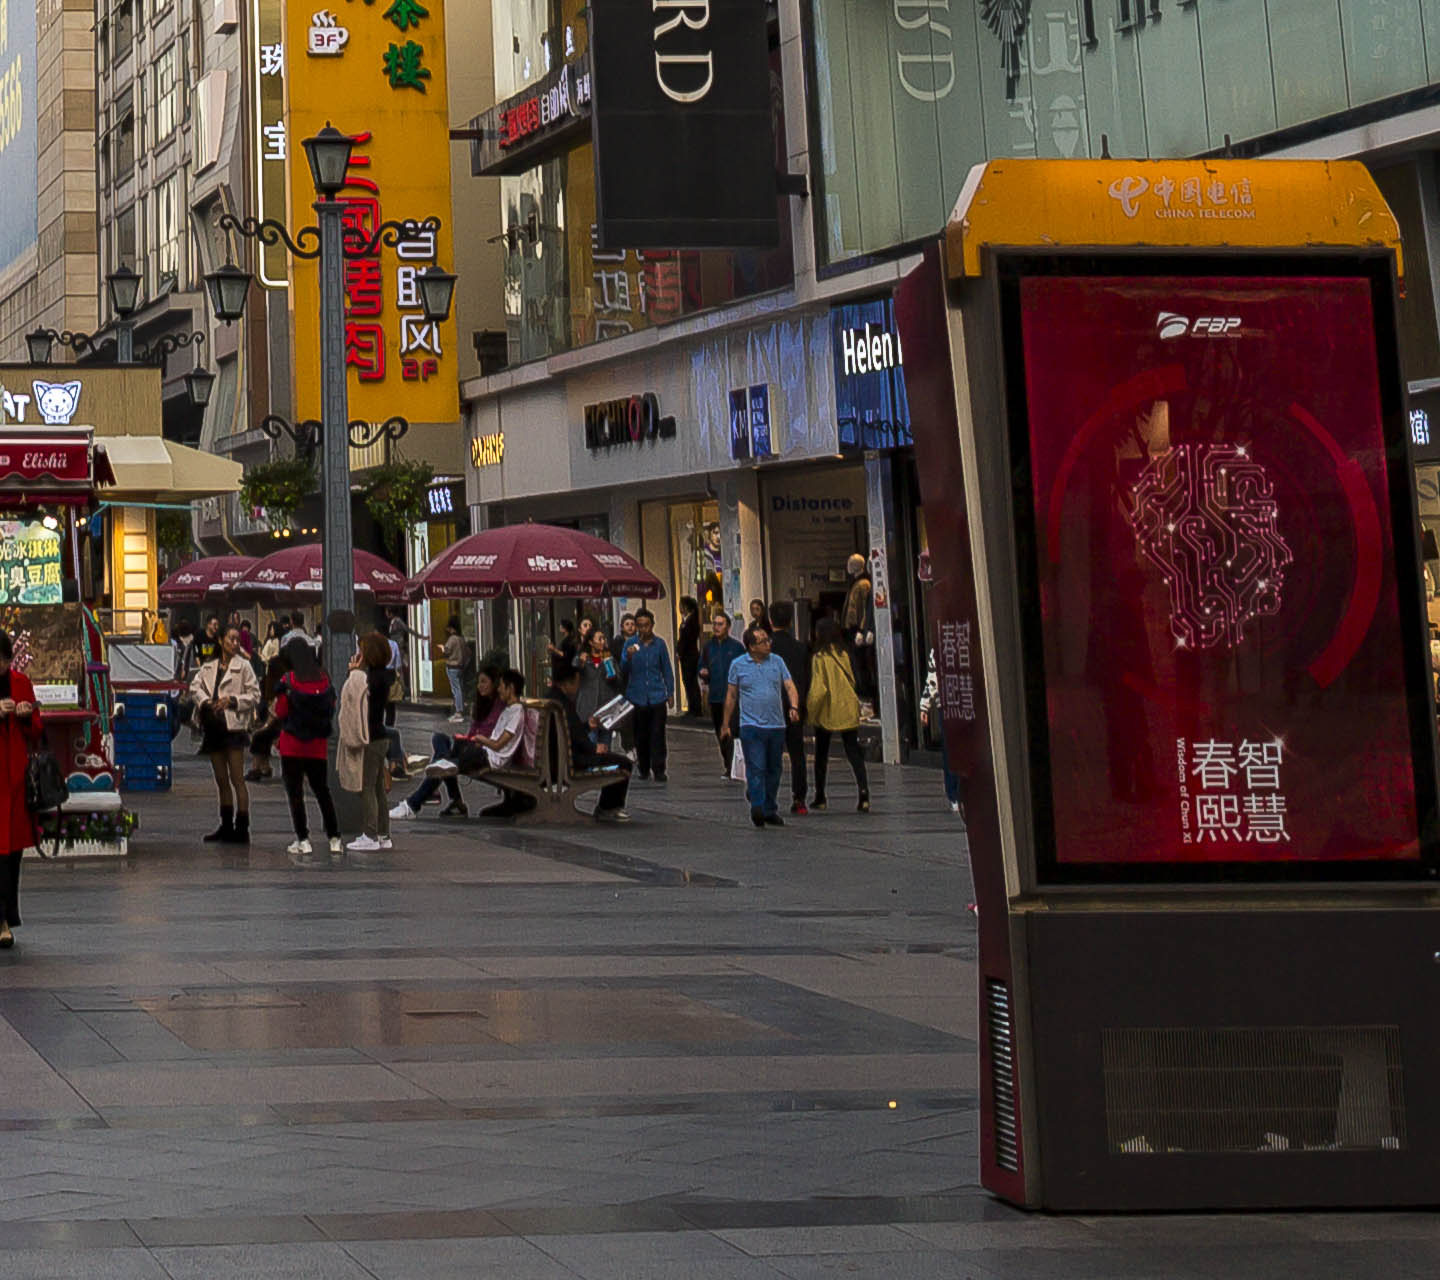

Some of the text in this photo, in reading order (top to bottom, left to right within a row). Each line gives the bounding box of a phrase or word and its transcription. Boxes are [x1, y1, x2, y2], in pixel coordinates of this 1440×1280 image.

[313, 32, 337, 47] 3F
[1153, 175, 1254, 208] 中国电信
[1155, 208, 1256, 219] CHINA TELECOM
[842, 322, 894, 377] Helen
[401, 358, 438, 379] 2F
